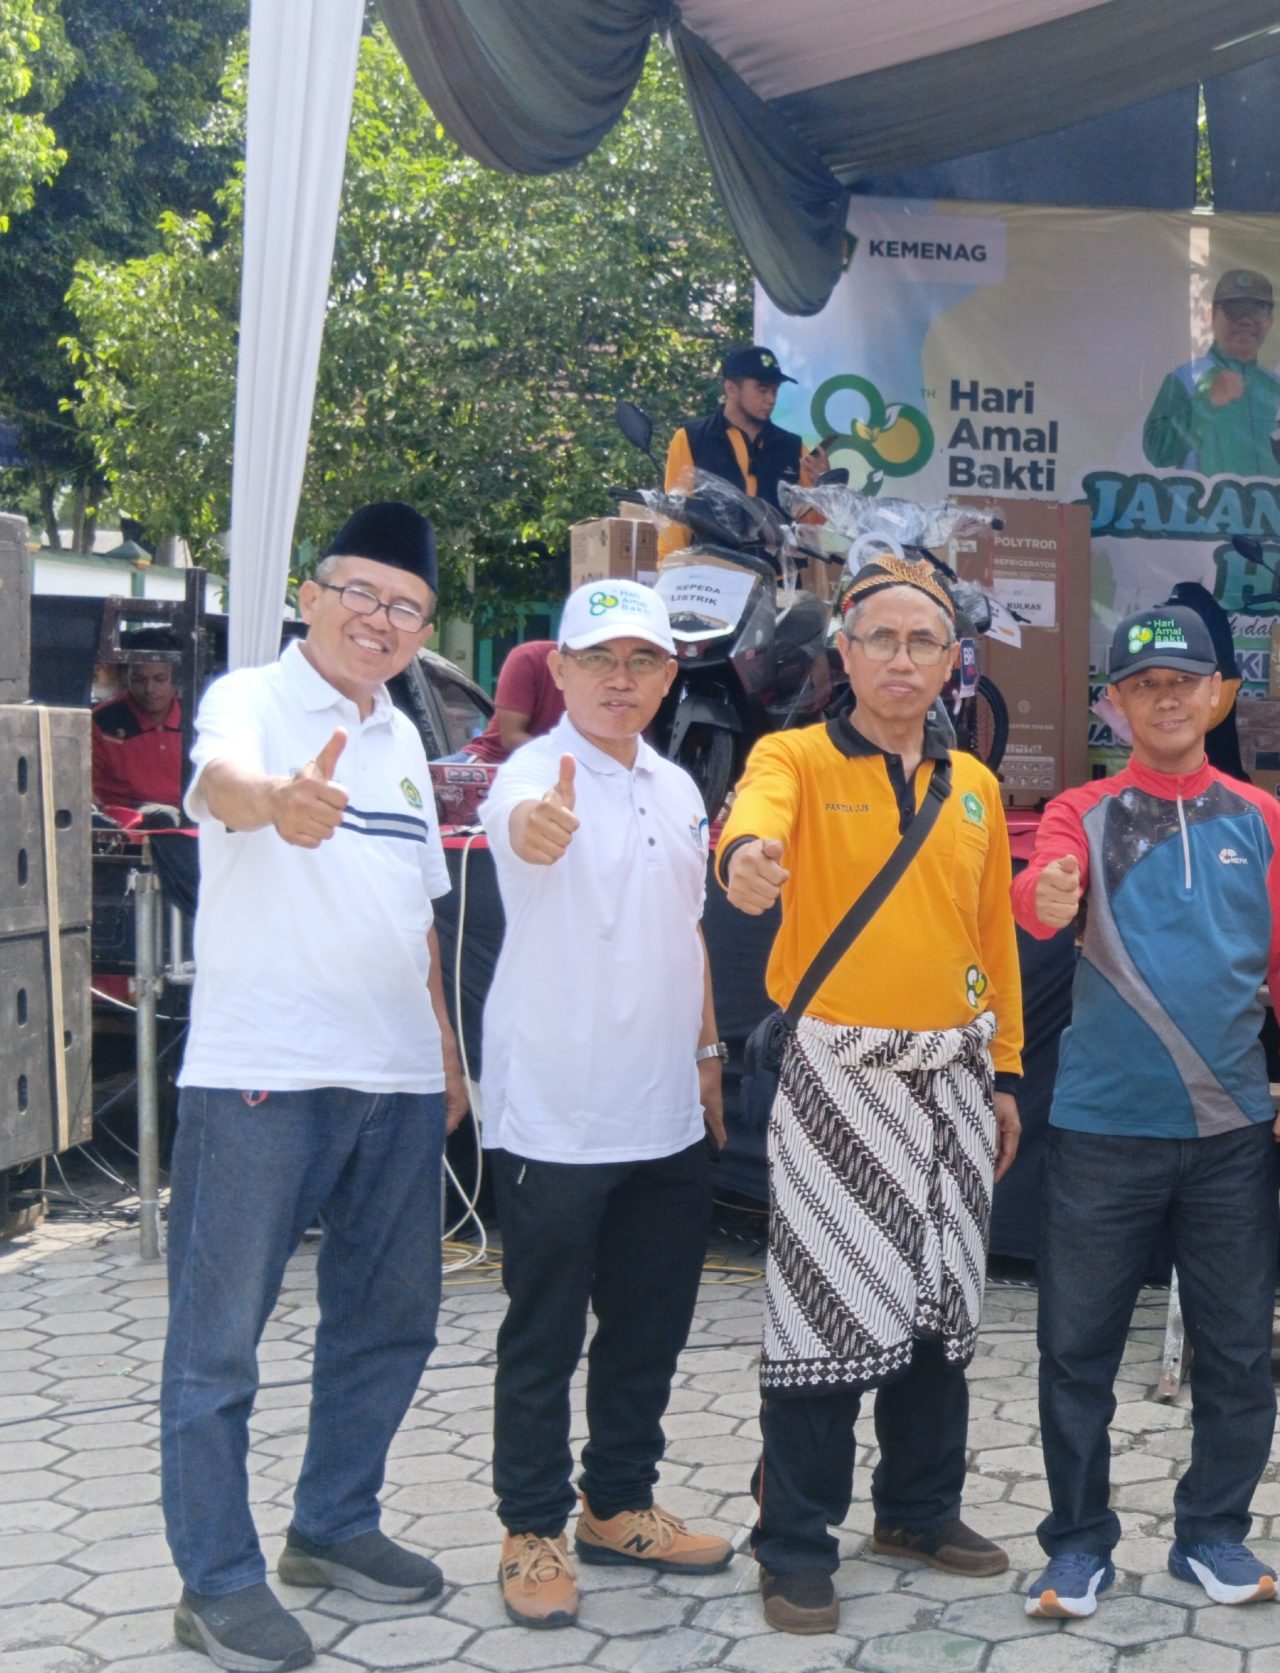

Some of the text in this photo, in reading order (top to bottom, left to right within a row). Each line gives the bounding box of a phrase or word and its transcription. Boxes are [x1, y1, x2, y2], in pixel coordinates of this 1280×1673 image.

[868, 239, 987, 263] KEMENAG
[920, 389, 936, 399] TH
[949, 379, 1035, 415] Hari
[947, 418, 1059, 455] Amal
[948, 456, 1056, 492] Bakti
[993, 536, 1057, 550] POLYTRON
[993, 558, 1056, 569] REFRIGERATOR
[676, 584, 721, 594] SEPEDA
[671, 594, 718, 606] LISTRIK
[1006, 602, 1042, 611] KULKAS
[1153, 619, 1175, 628] Hari
[1155, 627, 1182, 636] Amal
[1155, 635, 1185, 643] Bakti
[825, 803, 854, 813] PANITIA
